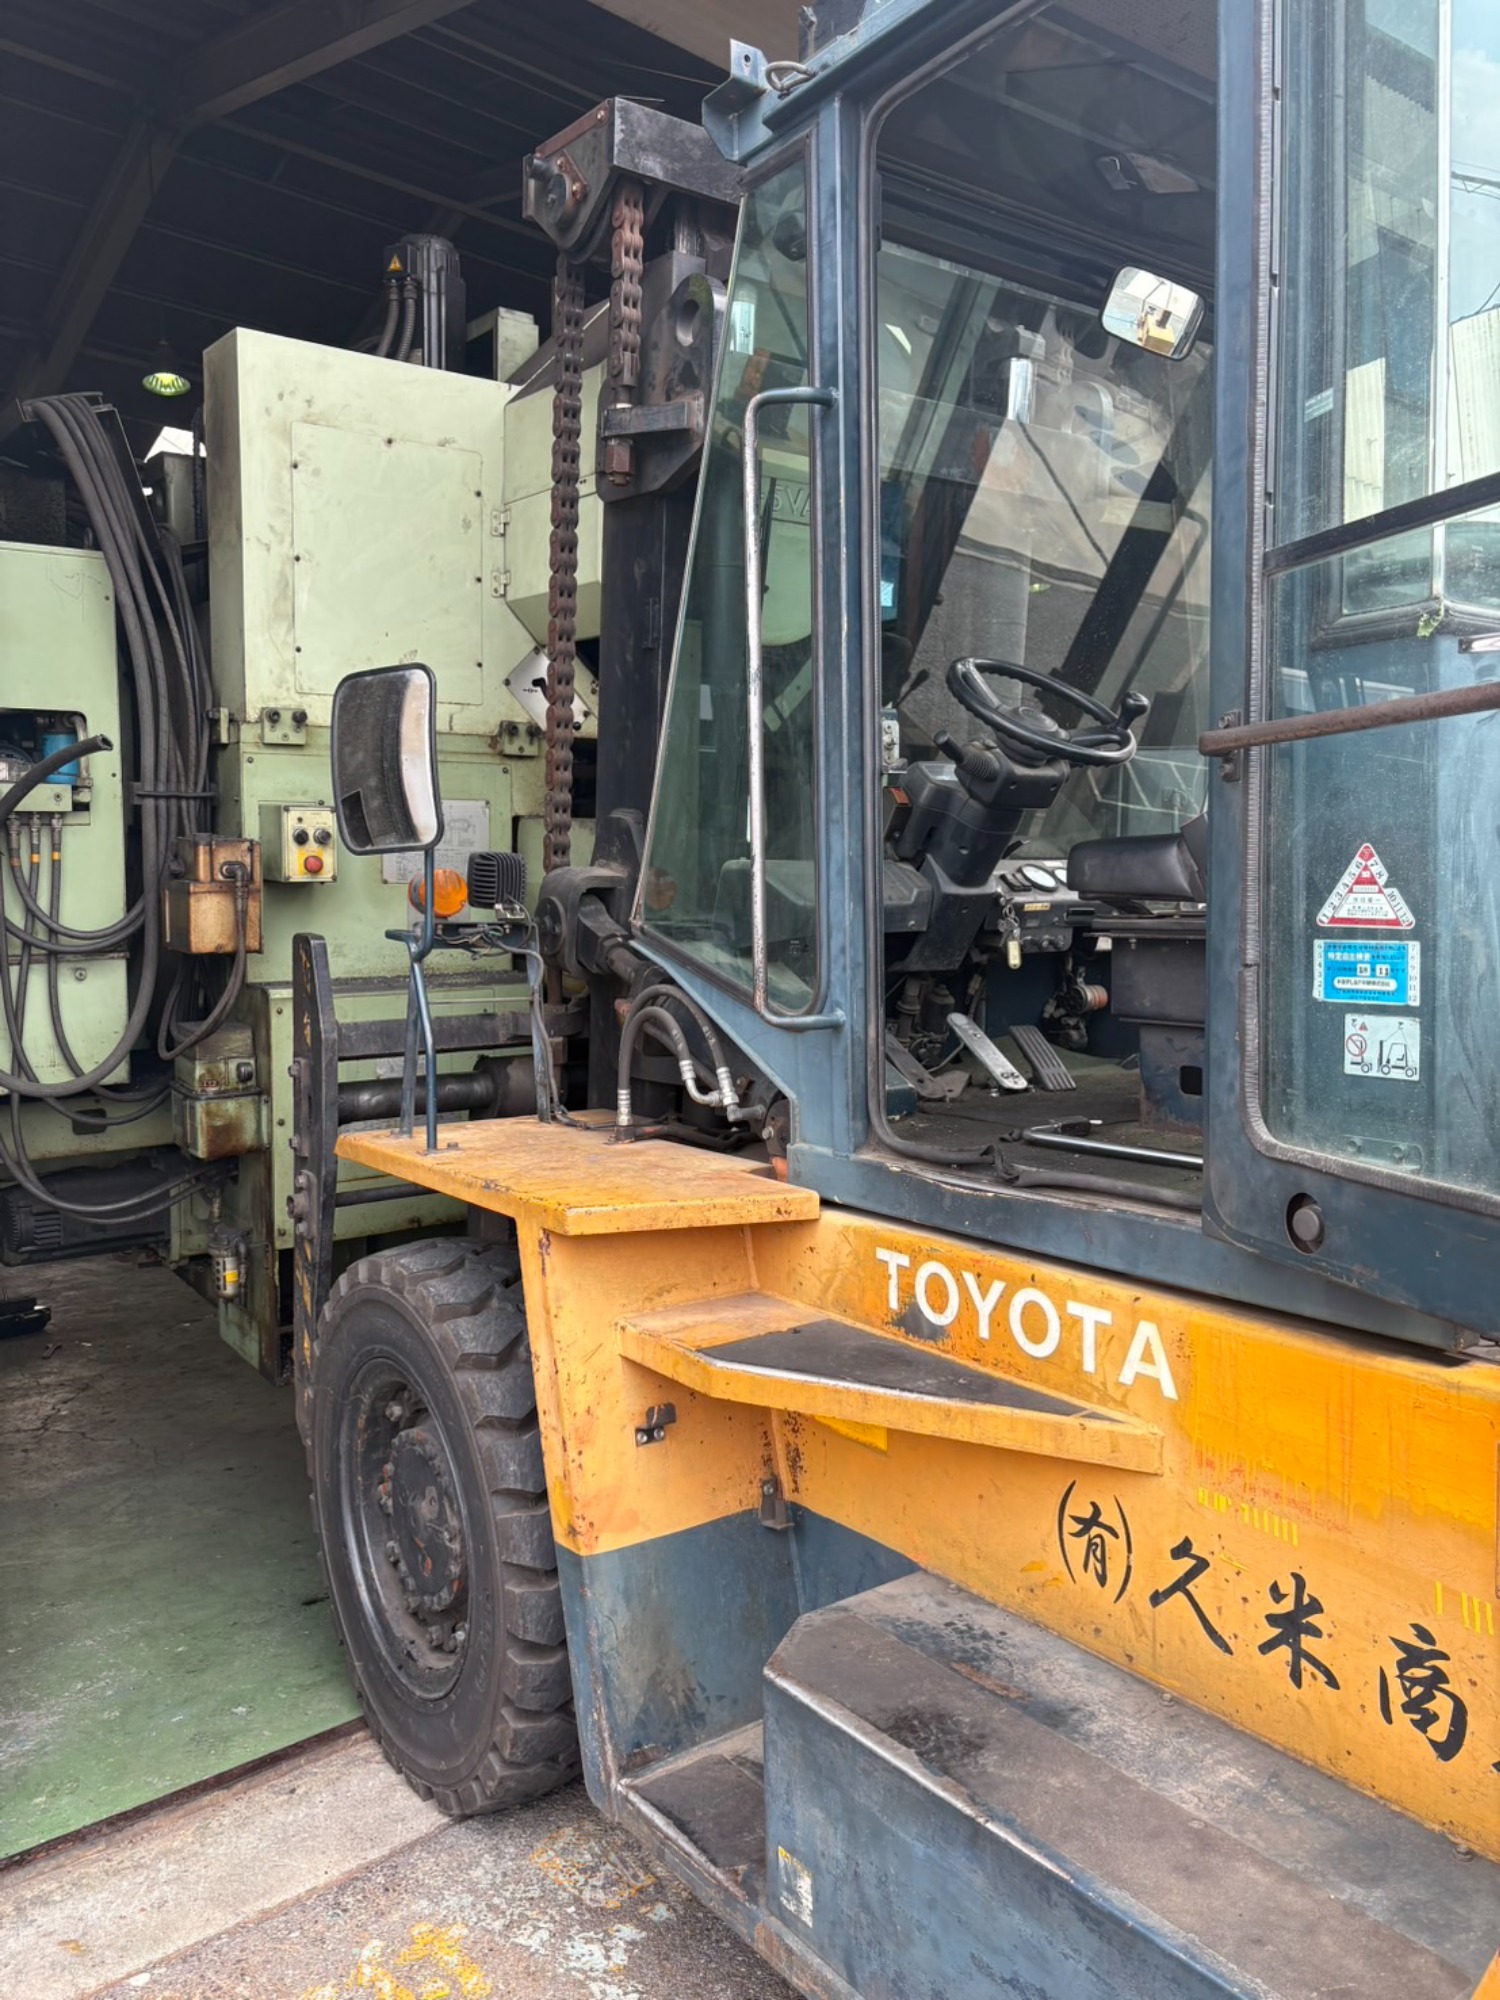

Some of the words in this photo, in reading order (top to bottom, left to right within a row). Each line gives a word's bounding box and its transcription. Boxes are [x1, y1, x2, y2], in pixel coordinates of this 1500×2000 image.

[876, 1247, 1179, 1400] TOYOTA
[1057, 1480, 1500, 1775] (有)久米商
